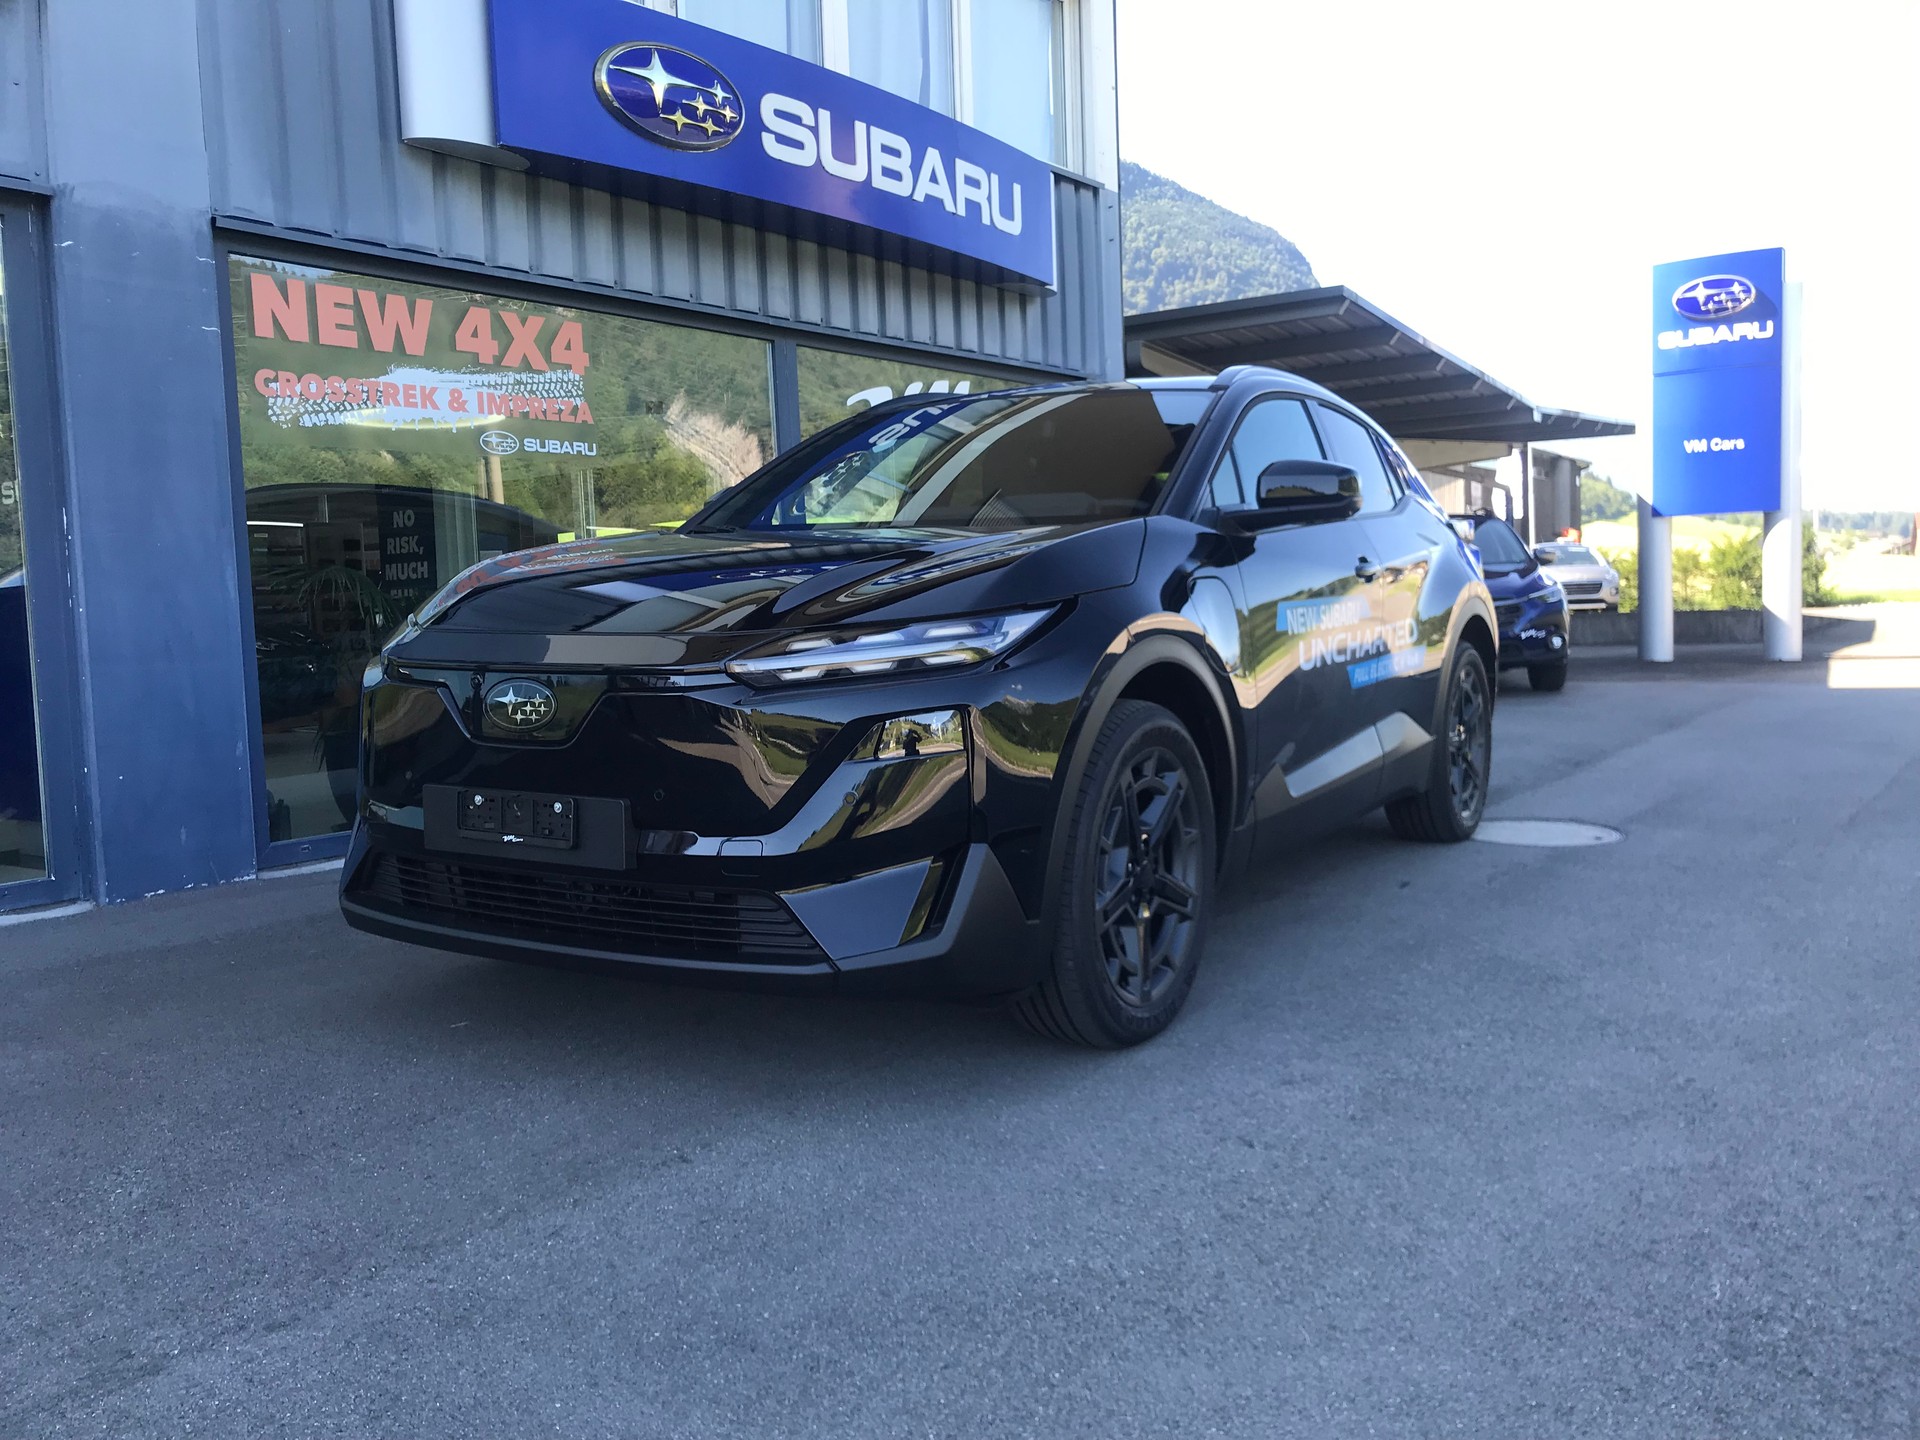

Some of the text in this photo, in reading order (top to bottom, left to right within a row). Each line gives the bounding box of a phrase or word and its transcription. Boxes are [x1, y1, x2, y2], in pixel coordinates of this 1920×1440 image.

[760, 93, 1022, 236] SUBARU
[250, 273, 590, 375] NEW 4X4
[1658, 320, 1774, 350] SUBARU
[254, 368, 595, 425] CROSSTREK & IMPREZA
[523, 438, 597, 456] SUBARU
[392, 509, 415, 528] NO
[387, 535, 424, 555] RISK,
[385, 561, 428, 580] MUCH
[1286, 605, 1317, 636] NEW
[1299, 616, 1419, 671] UNCHARTED
